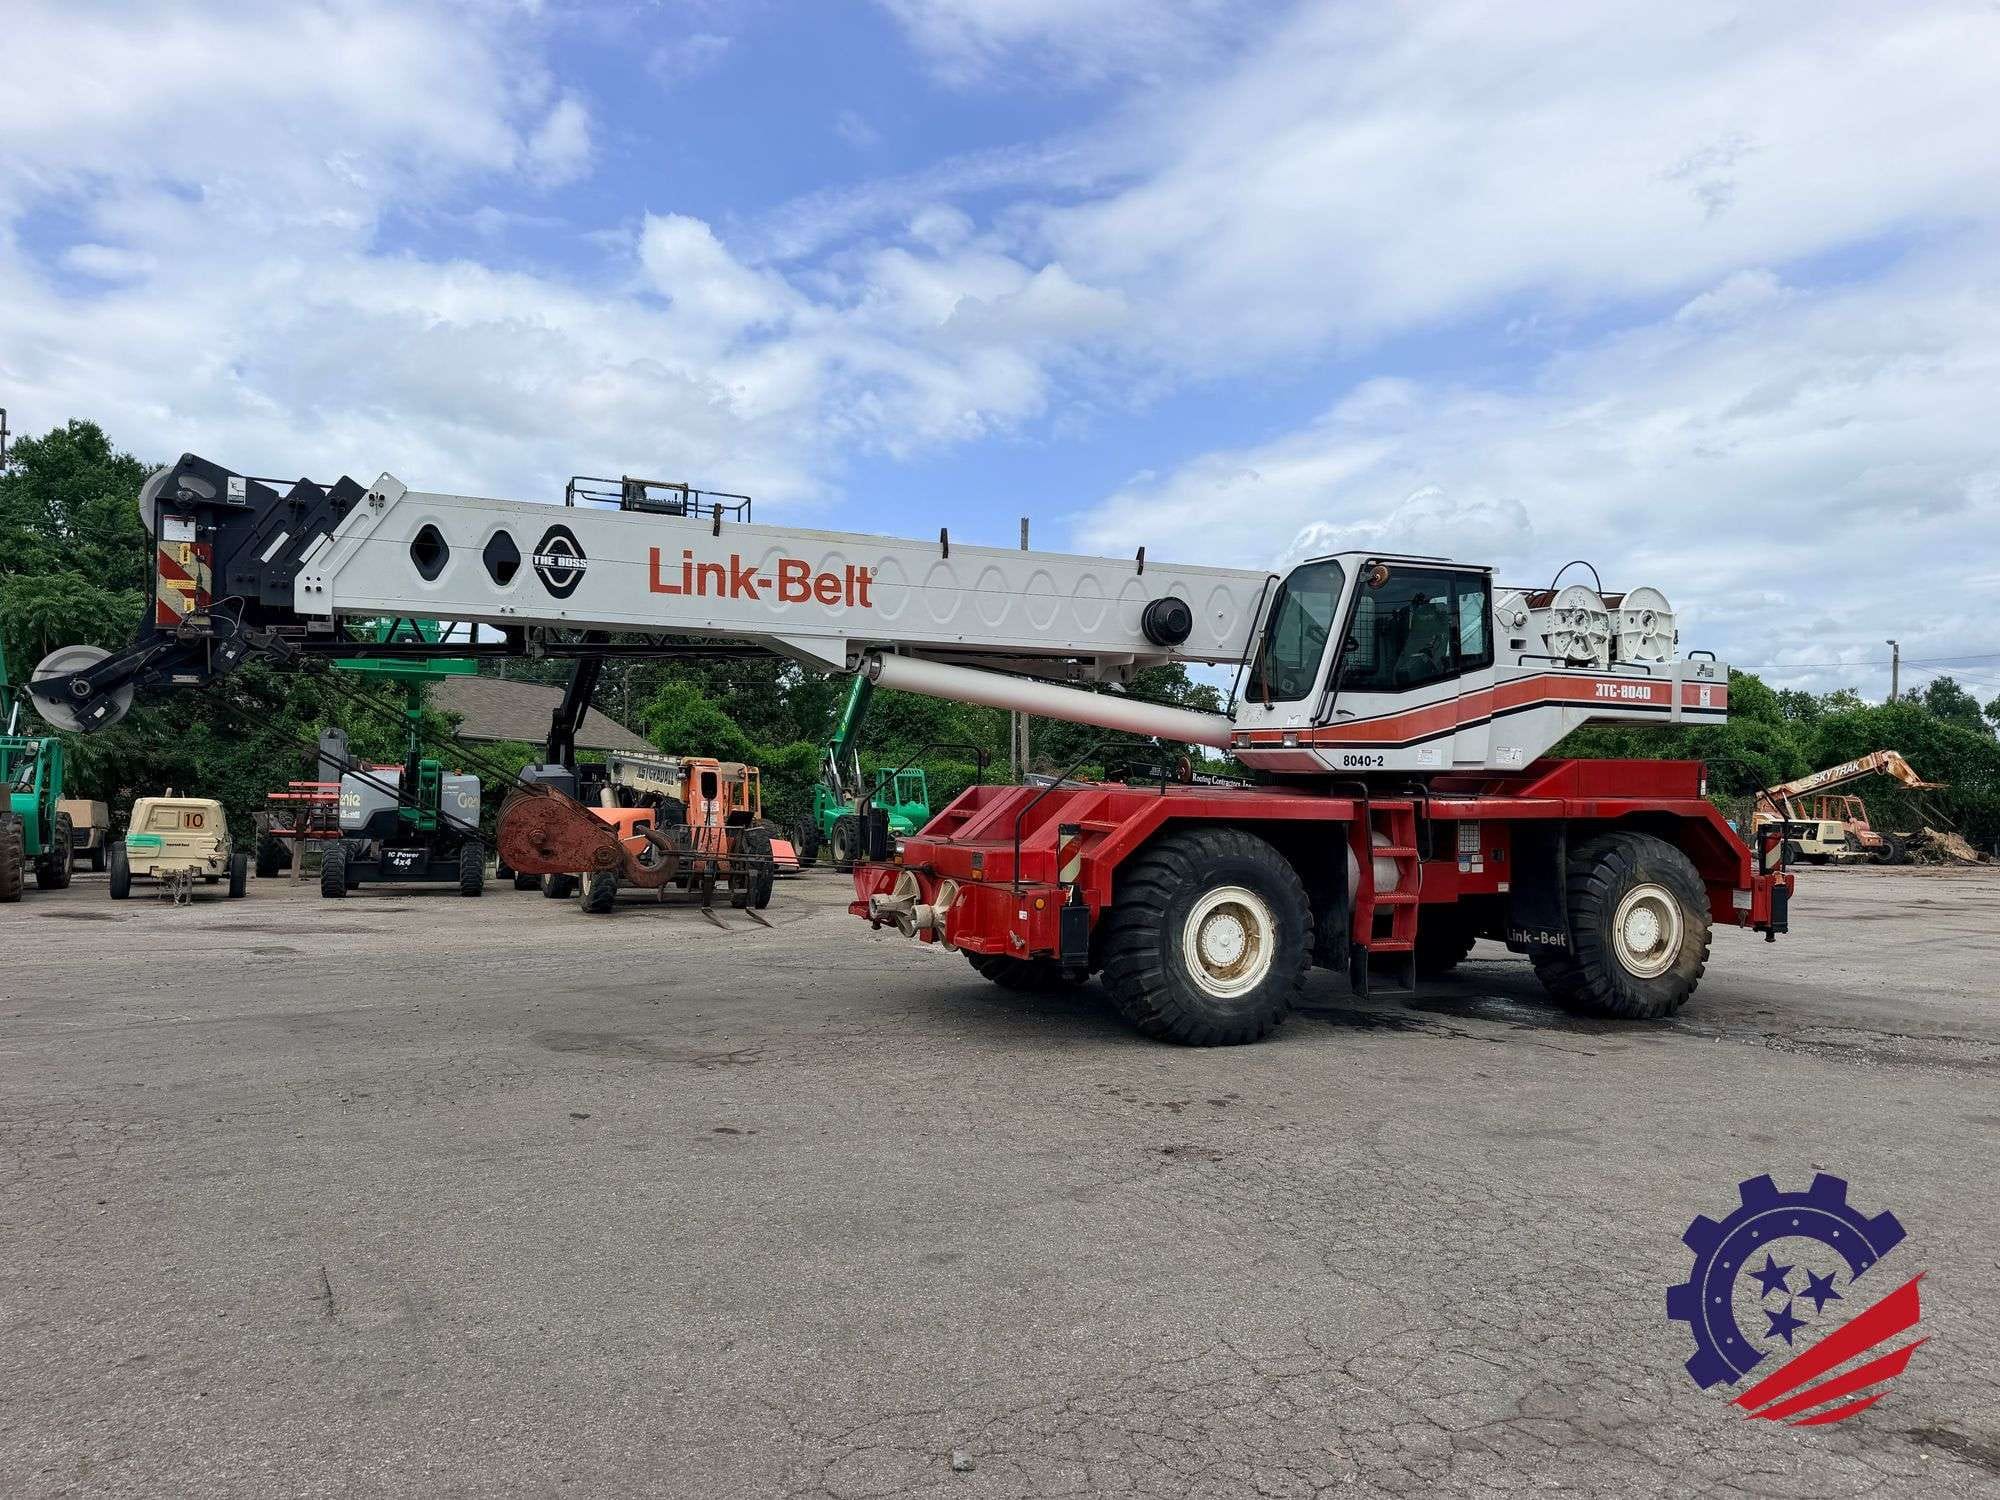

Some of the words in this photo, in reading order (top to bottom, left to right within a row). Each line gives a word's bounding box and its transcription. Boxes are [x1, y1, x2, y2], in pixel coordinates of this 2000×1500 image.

[533, 554, 556, 566] THE
[557, 557, 587, 568] BOSS
[649, 547, 873, 608] Link-Belt
[1343, 755, 1384, 767] 8040-2
[1192, 772, 1212, 785] Roofing
[1814, 769, 1833, 784] SKY
[1834, 760, 1860, 777] TRAK
[185, 813, 204, 828] 10
[392, 858, 412, 866] 4x4
[396, 851, 420, 859] Power
[1506, 927, 1566, 947] Link-Belt
